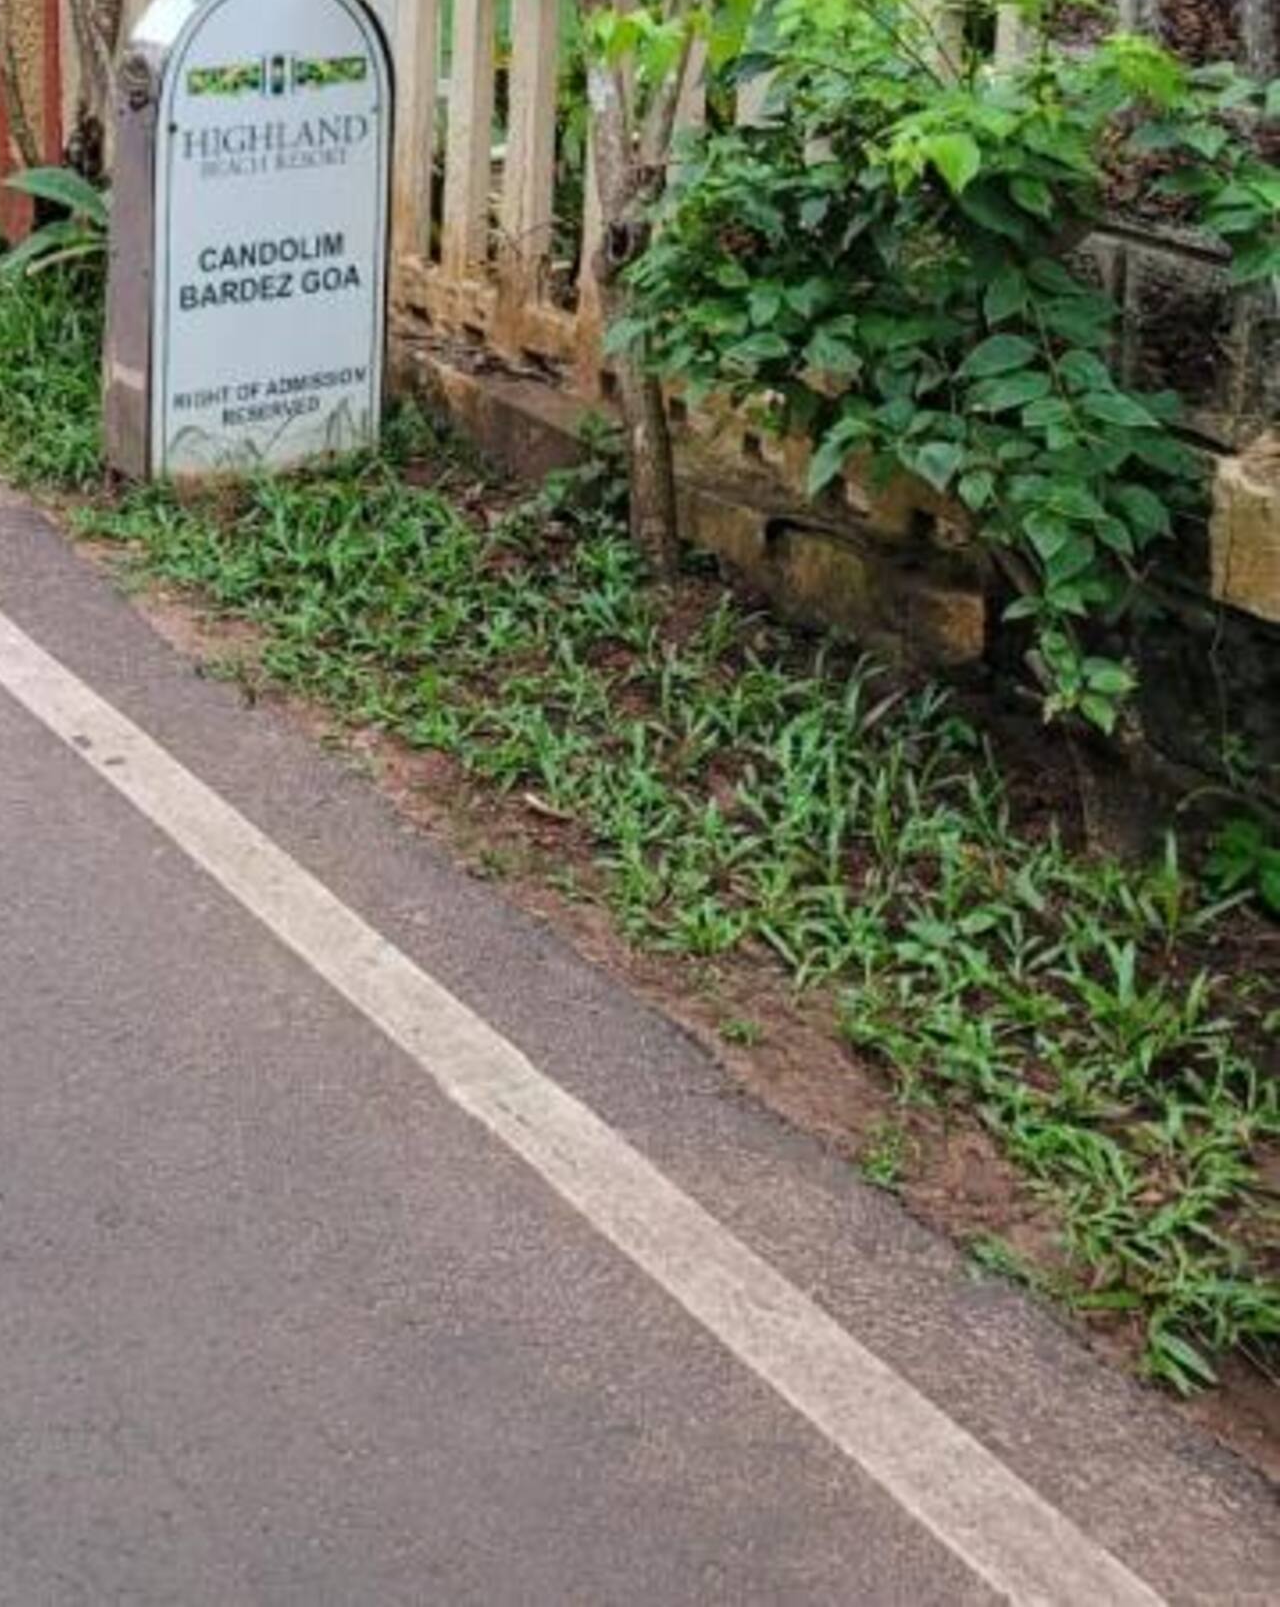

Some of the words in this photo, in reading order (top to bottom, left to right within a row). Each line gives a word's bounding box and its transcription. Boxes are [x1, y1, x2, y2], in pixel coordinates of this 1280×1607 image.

[184, 114, 368, 159] HIGHLAND
[198, 232, 344, 272] CANDOLIM
[180, 272, 293, 311] BARDEZ
[301, 264, 360, 294] GOA
[237, 381, 262, 400] OF
[266, 367, 366, 395] ADMISSION
[222, 396, 320, 425] RESERVED
